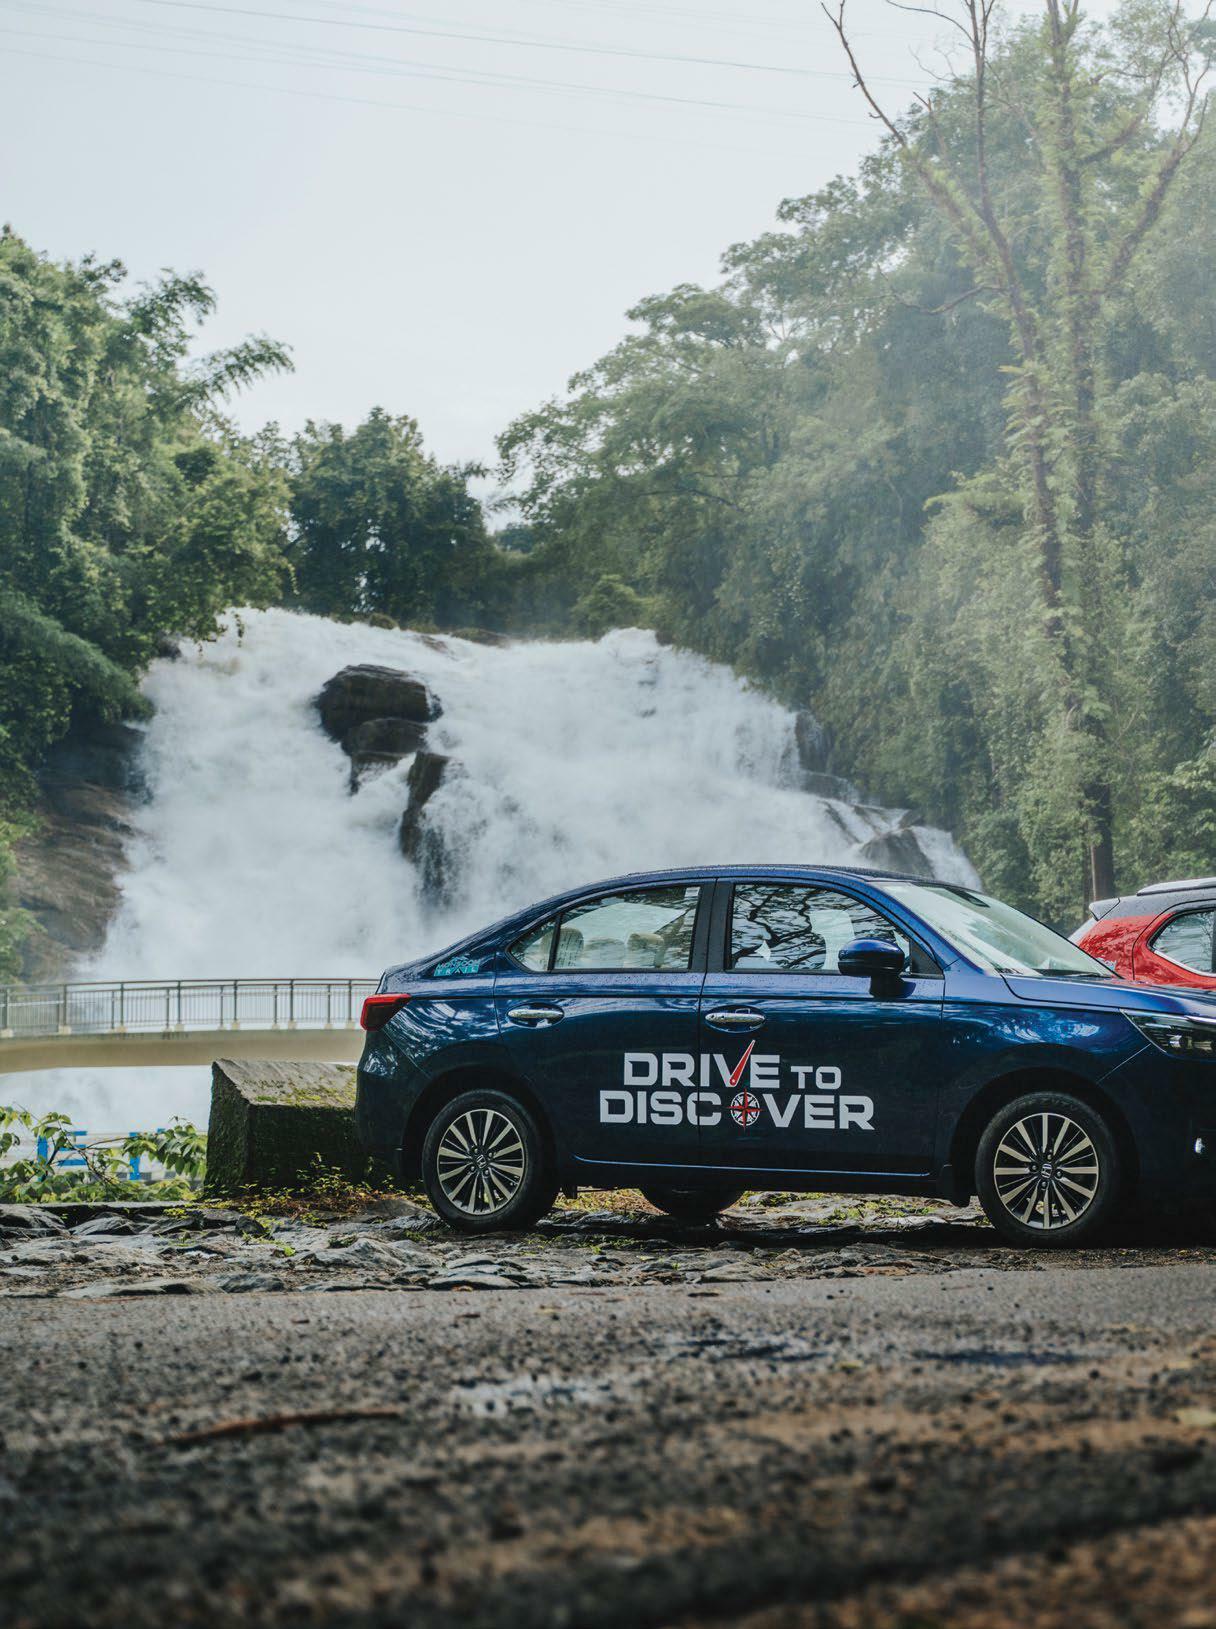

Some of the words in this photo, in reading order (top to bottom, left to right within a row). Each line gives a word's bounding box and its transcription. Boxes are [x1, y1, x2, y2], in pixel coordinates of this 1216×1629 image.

[437, 965, 478, 976] TRAIL
[624, 1040, 780, 1089] DRIVE
[790, 1065, 842, 1090] TO
[600, 1089, 875, 1131] DISCOVER
